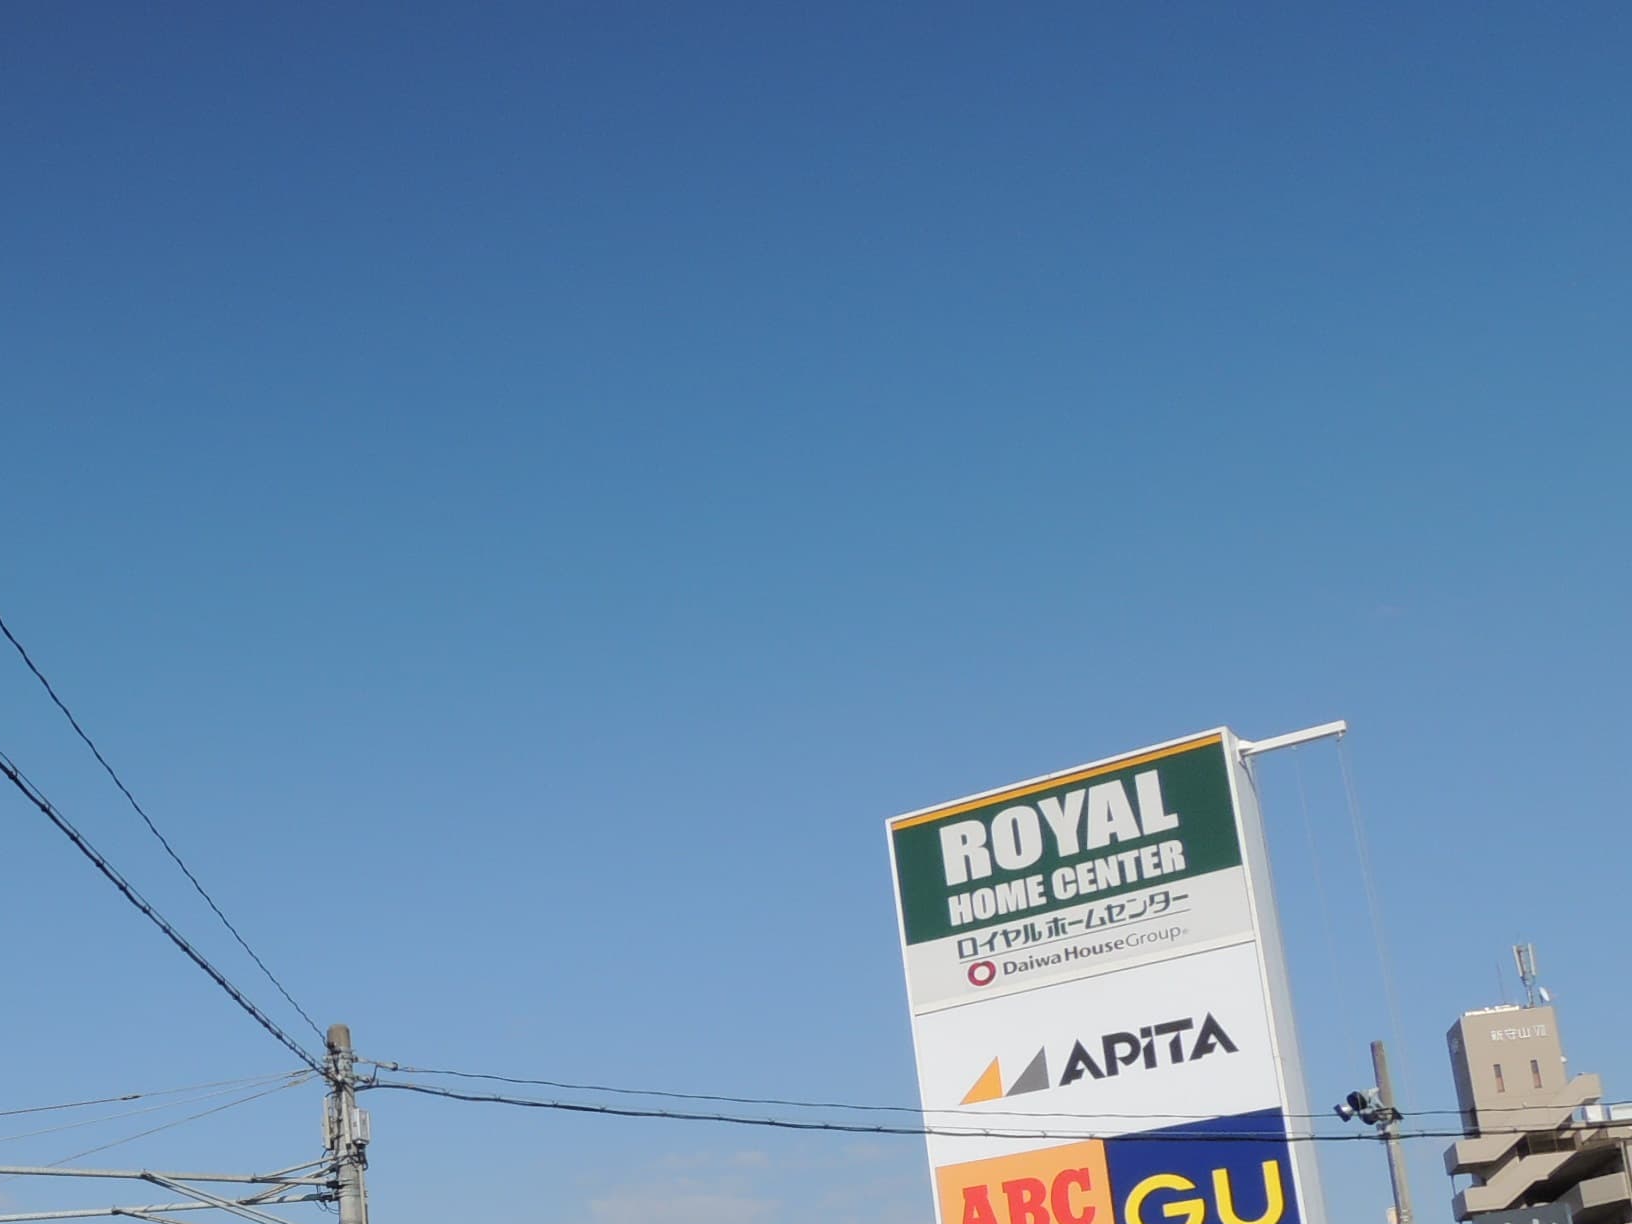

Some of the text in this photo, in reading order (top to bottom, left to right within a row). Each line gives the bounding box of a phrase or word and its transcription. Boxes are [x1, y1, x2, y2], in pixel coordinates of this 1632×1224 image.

[939, 769, 1179, 886] ROYAL
[948, 840, 1186, 926] HOME CENTER
[957, 890, 1189, 960] ロイヤルホームセンター
